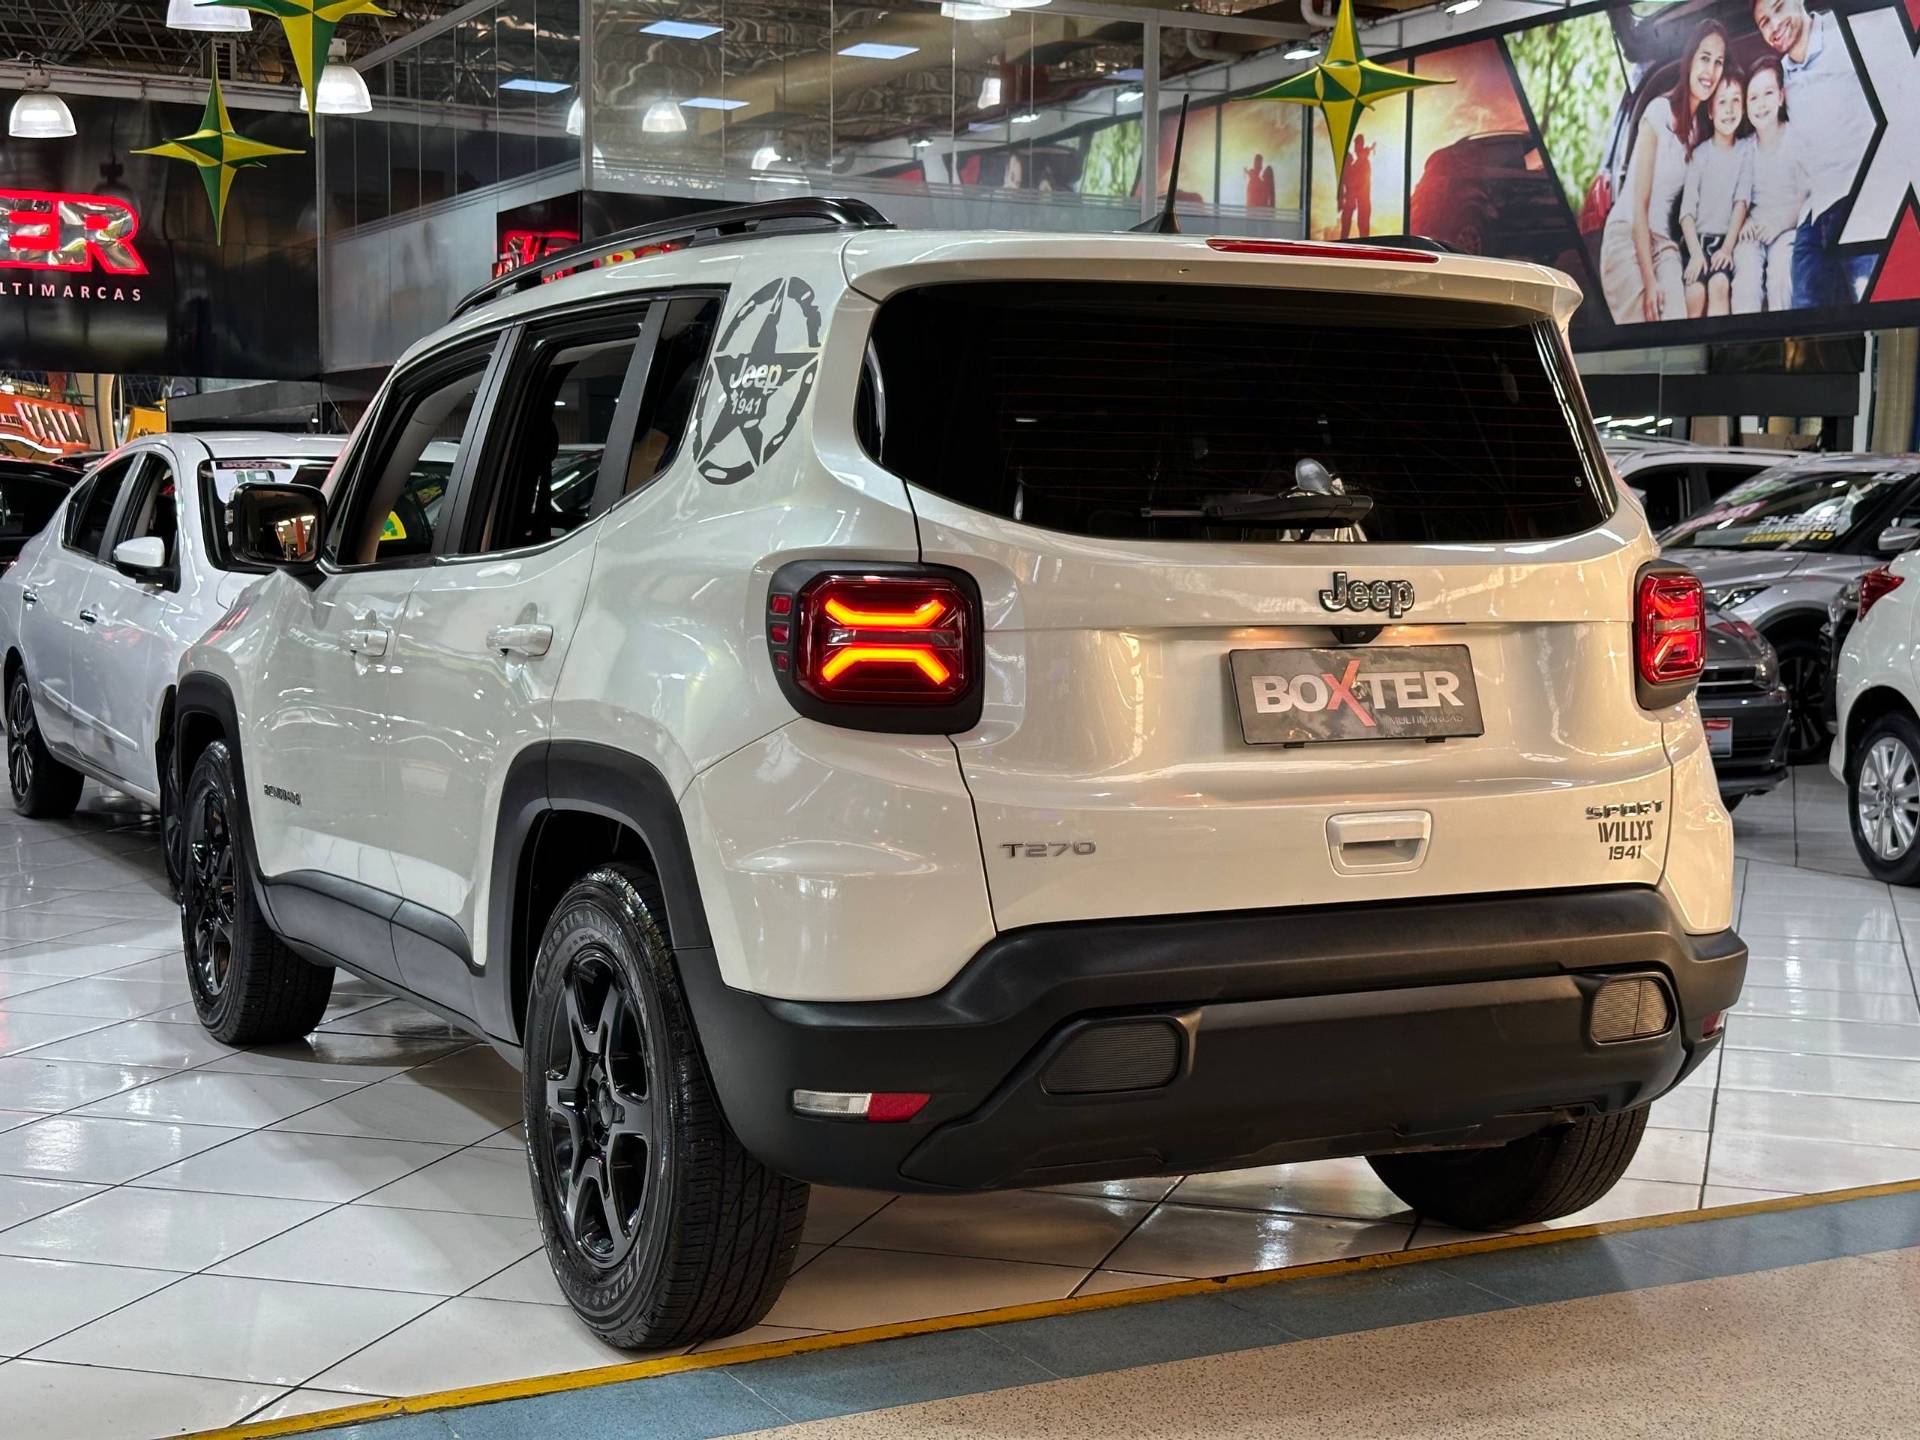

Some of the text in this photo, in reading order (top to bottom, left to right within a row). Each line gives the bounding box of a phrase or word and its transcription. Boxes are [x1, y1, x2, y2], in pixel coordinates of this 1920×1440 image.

[729, 357, 783, 395] Jeep
[731, 397, 762, 415] 1941
[1319, 571, 1415, 618] Jeep
[1251, 659, 1465, 727] BOXTER
[1585, 800, 1663, 820] SPORT
[1598, 820, 1654, 843] WILLYS
[1001, 841, 1097, 858] T270
[1608, 845, 1643, 860] 1941
